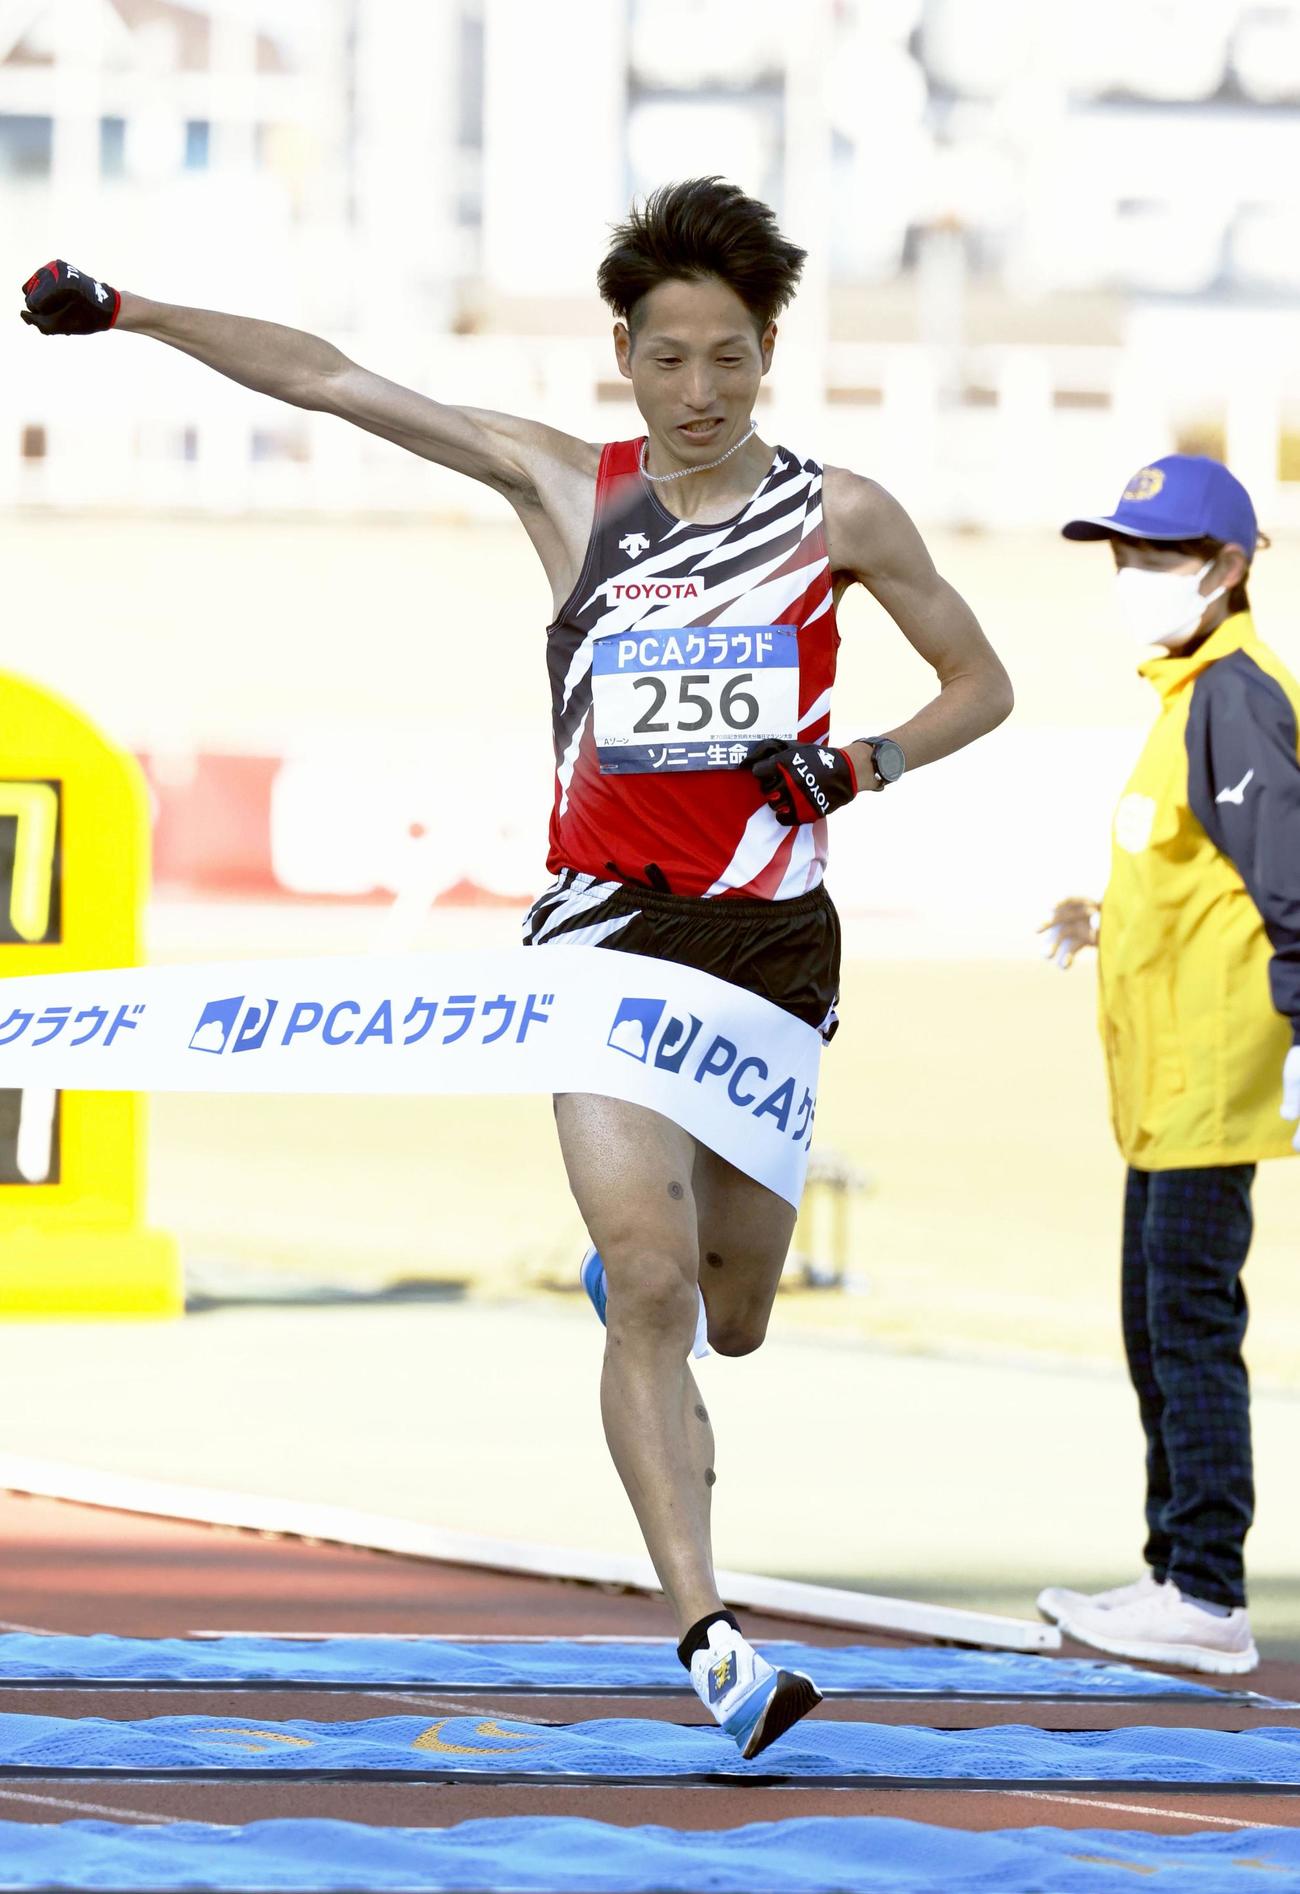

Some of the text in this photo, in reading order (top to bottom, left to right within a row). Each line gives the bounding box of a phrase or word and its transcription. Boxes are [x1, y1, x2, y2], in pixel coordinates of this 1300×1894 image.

[612, 582, 698, 600] TOYOTA
[616, 632, 774, 669] PCAクラウド
[631, 673, 760, 734] 256
[647, 743, 749, 769] ソニー生命
[791, 752, 830, 814] TOYOTA
[280, 993, 555, 1046] PCAクラウド
[693, 1034, 817, 1152] PCAク
